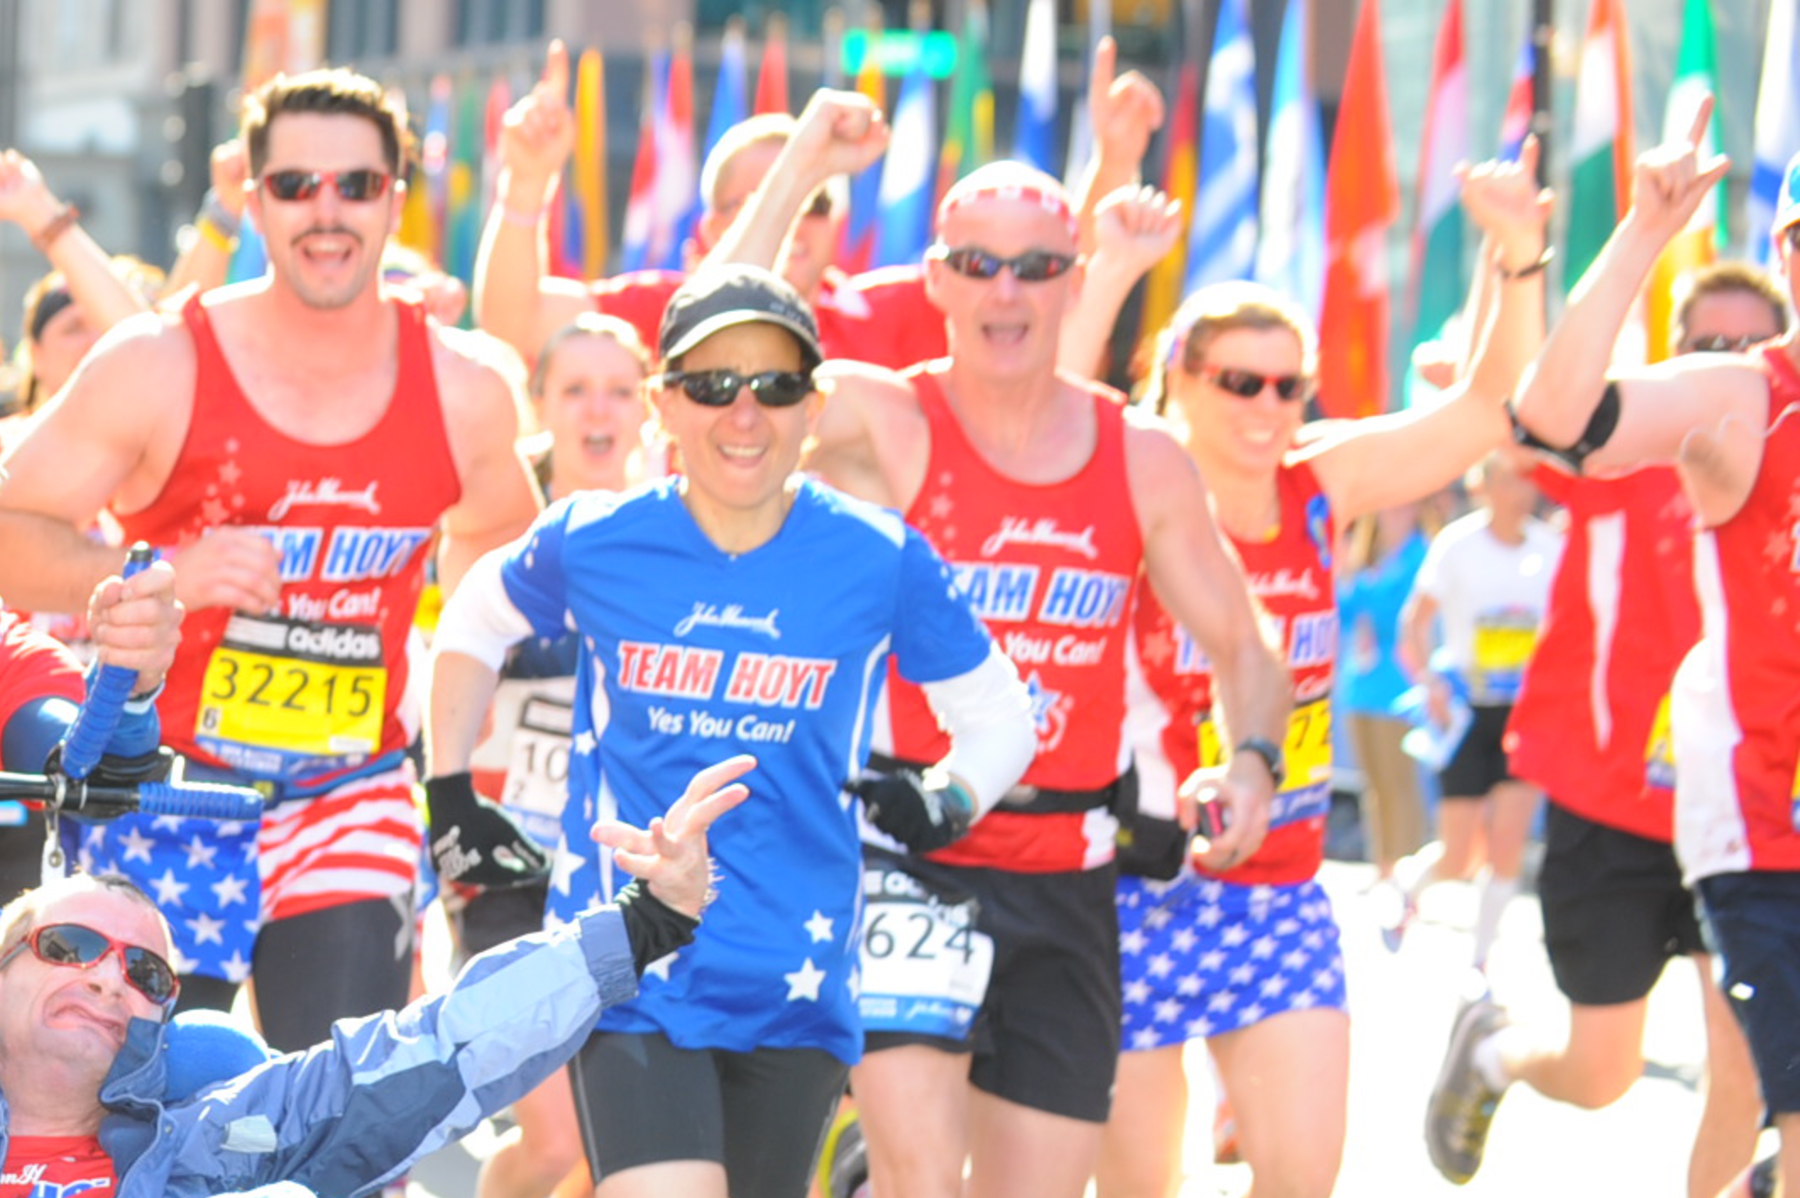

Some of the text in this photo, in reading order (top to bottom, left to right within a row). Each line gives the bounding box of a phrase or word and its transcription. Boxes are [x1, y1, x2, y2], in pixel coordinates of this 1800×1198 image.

[287, 625, 381, 659] adidas
[1003, 630, 1053, 665] You
[210, 656, 375, 718] 32215
[616, 639, 839, 710] TEAM HOYT
[647, 705, 797, 744] Yes You Can!
